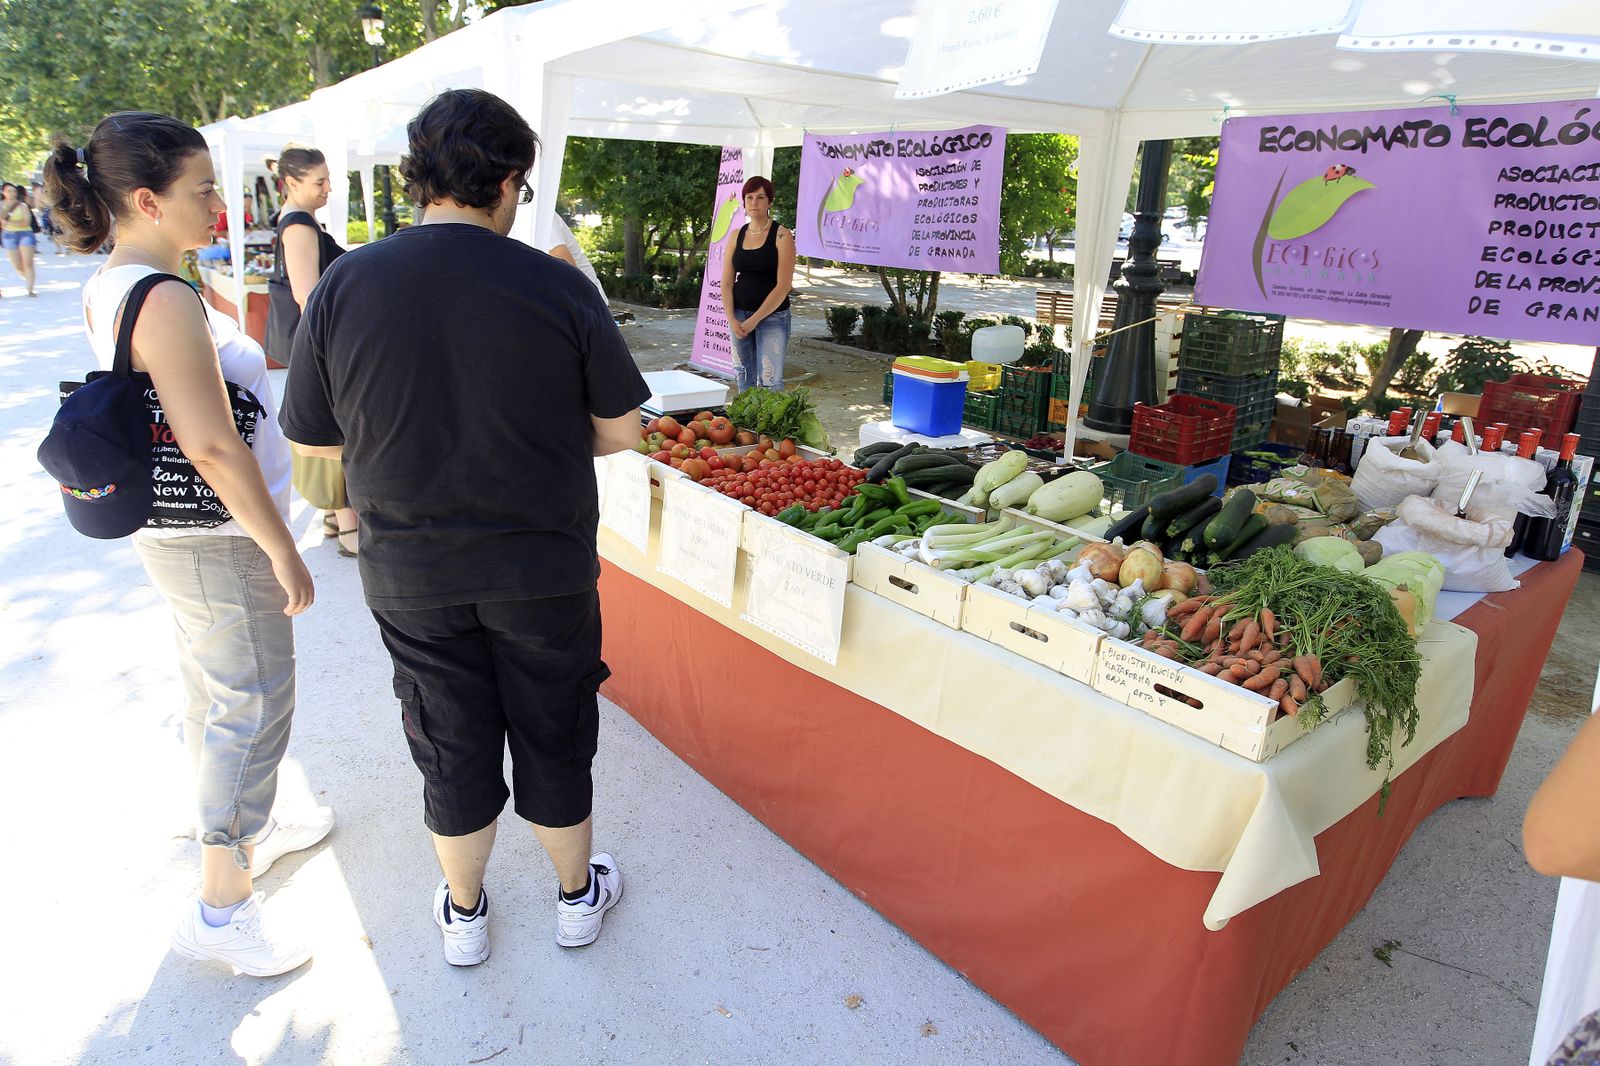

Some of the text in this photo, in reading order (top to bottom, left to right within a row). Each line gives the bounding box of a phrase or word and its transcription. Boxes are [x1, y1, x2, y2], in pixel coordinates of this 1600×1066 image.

[1259, 119, 1451, 154] ECONOMATO
[816, 132, 993, 161] ECONOMATO ECOLÓGICO
[915, 160, 982, 177] ASOCIACIÓN DE
[918, 178, 981, 193] PRODUCTORES Y
[917, 195, 979, 208] PRODUCTORAS
[914, 213, 978, 225] ECOLÓGICOS
[911, 230, 977, 242] DE LA PROVINCIA
[908, 246, 977, 259] DE GRANADA
[1474, 270, 1502, 289] DE
[1506, 274, 1531, 291] LA
[1468, 296, 1600, 322] DE GRAN
[805, 567, 836, 589] VERDE
